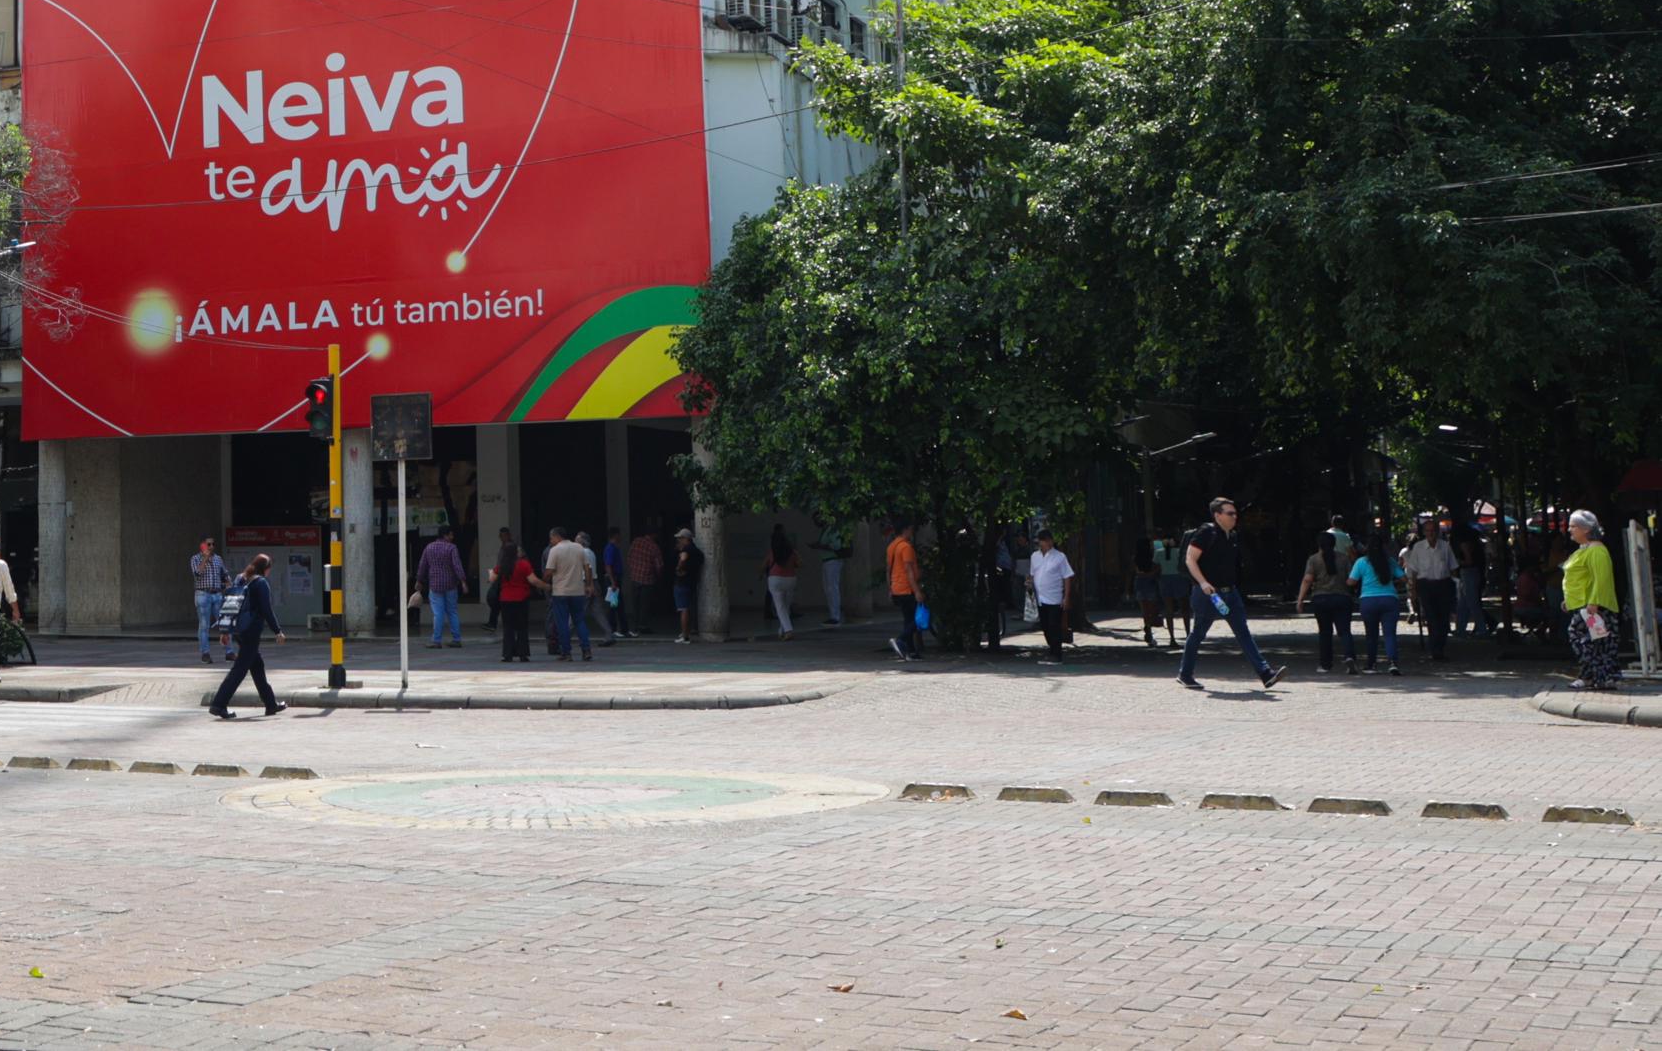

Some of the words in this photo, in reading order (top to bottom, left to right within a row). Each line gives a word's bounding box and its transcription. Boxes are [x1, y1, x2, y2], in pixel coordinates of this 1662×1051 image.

[201, 52, 464, 149] Neiva
[204, 161, 256, 201] te
[260, 138, 503, 232] ama
[174, 299, 339, 344] ¡ÁMALA
[351, 302, 384, 327] tú
[393, 287, 544, 325] también!
